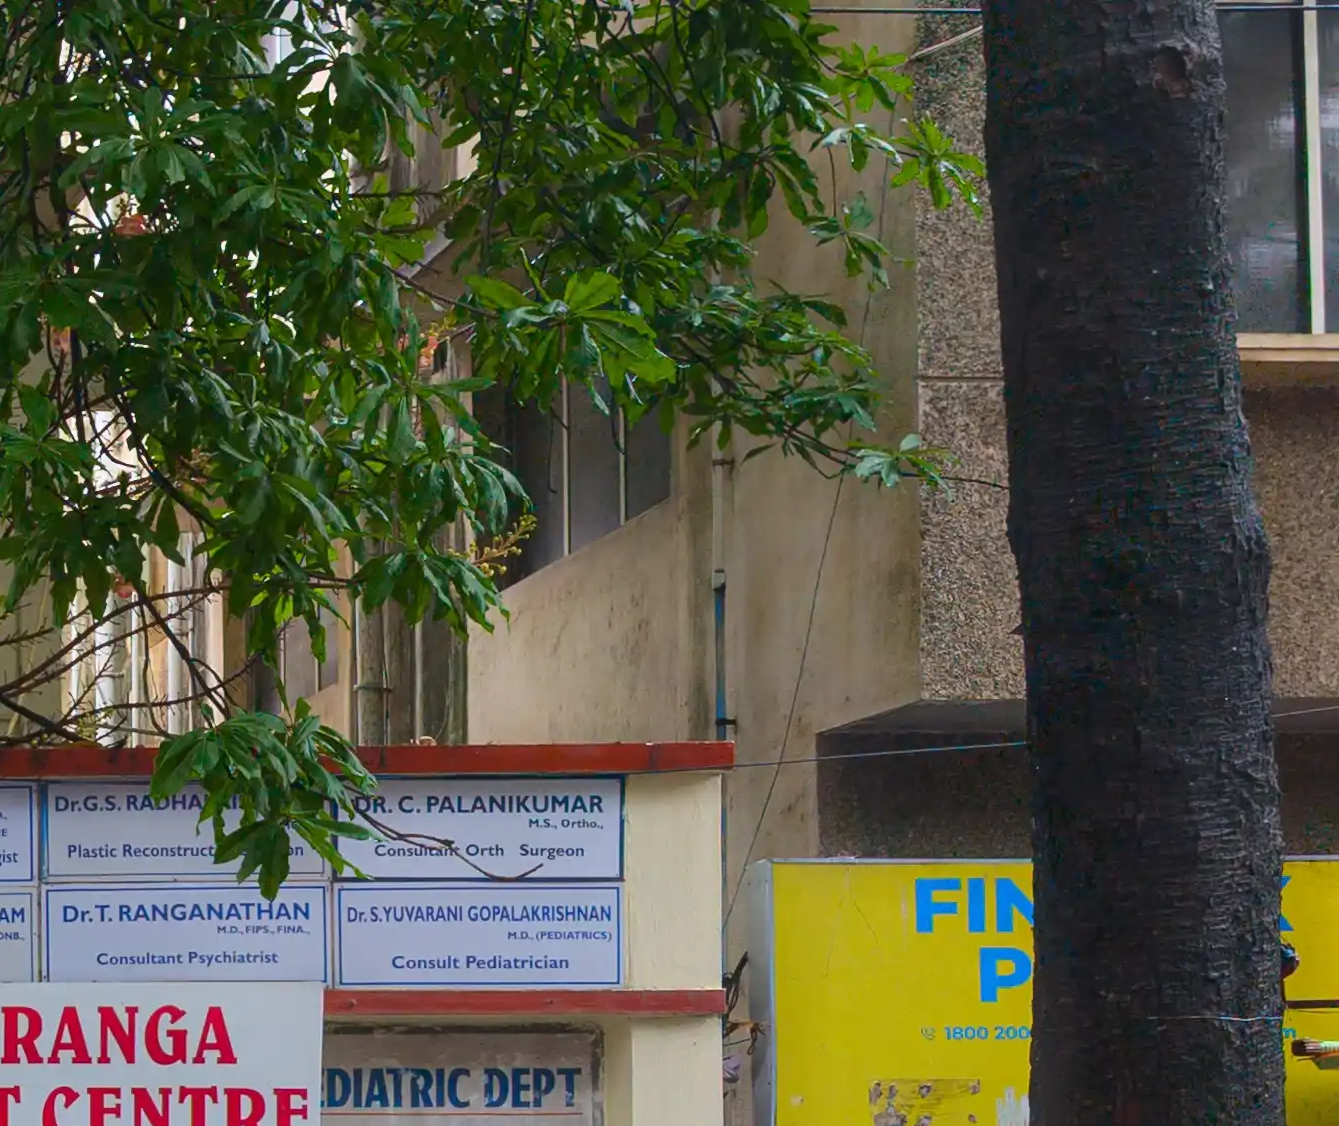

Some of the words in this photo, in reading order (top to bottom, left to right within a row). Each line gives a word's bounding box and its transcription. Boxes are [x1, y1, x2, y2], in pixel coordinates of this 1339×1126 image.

[399, 795, 422, 813] C.
[426, 794, 604, 813] PALANIKUMAR
[67, 844, 118, 858] Plastic
[374, 844, 460, 858] Consultant
[465, 844, 505, 858] Orth
[519, 844, 585, 860] Surgeon
[118, 901, 311, 921] RANGANATHAN
[467, 905, 612, 923] GOPALAKRISHNAN
[535, 929, 613, 943] (PEDIATRICS)
[96, 952, 184, 966] Consultant
[187, 950, 279, 967] Psychiatrist
[391, 955, 462, 970] Consult
[466, 954, 570, 970] Pediatrician
[0, 1004, 238, 1066] RANGA
[944, 1026, 989, 1040] 1800
[320, 1067, 472, 1109] DIATRIC
[483, 1067, 583, 1109] DEPT
